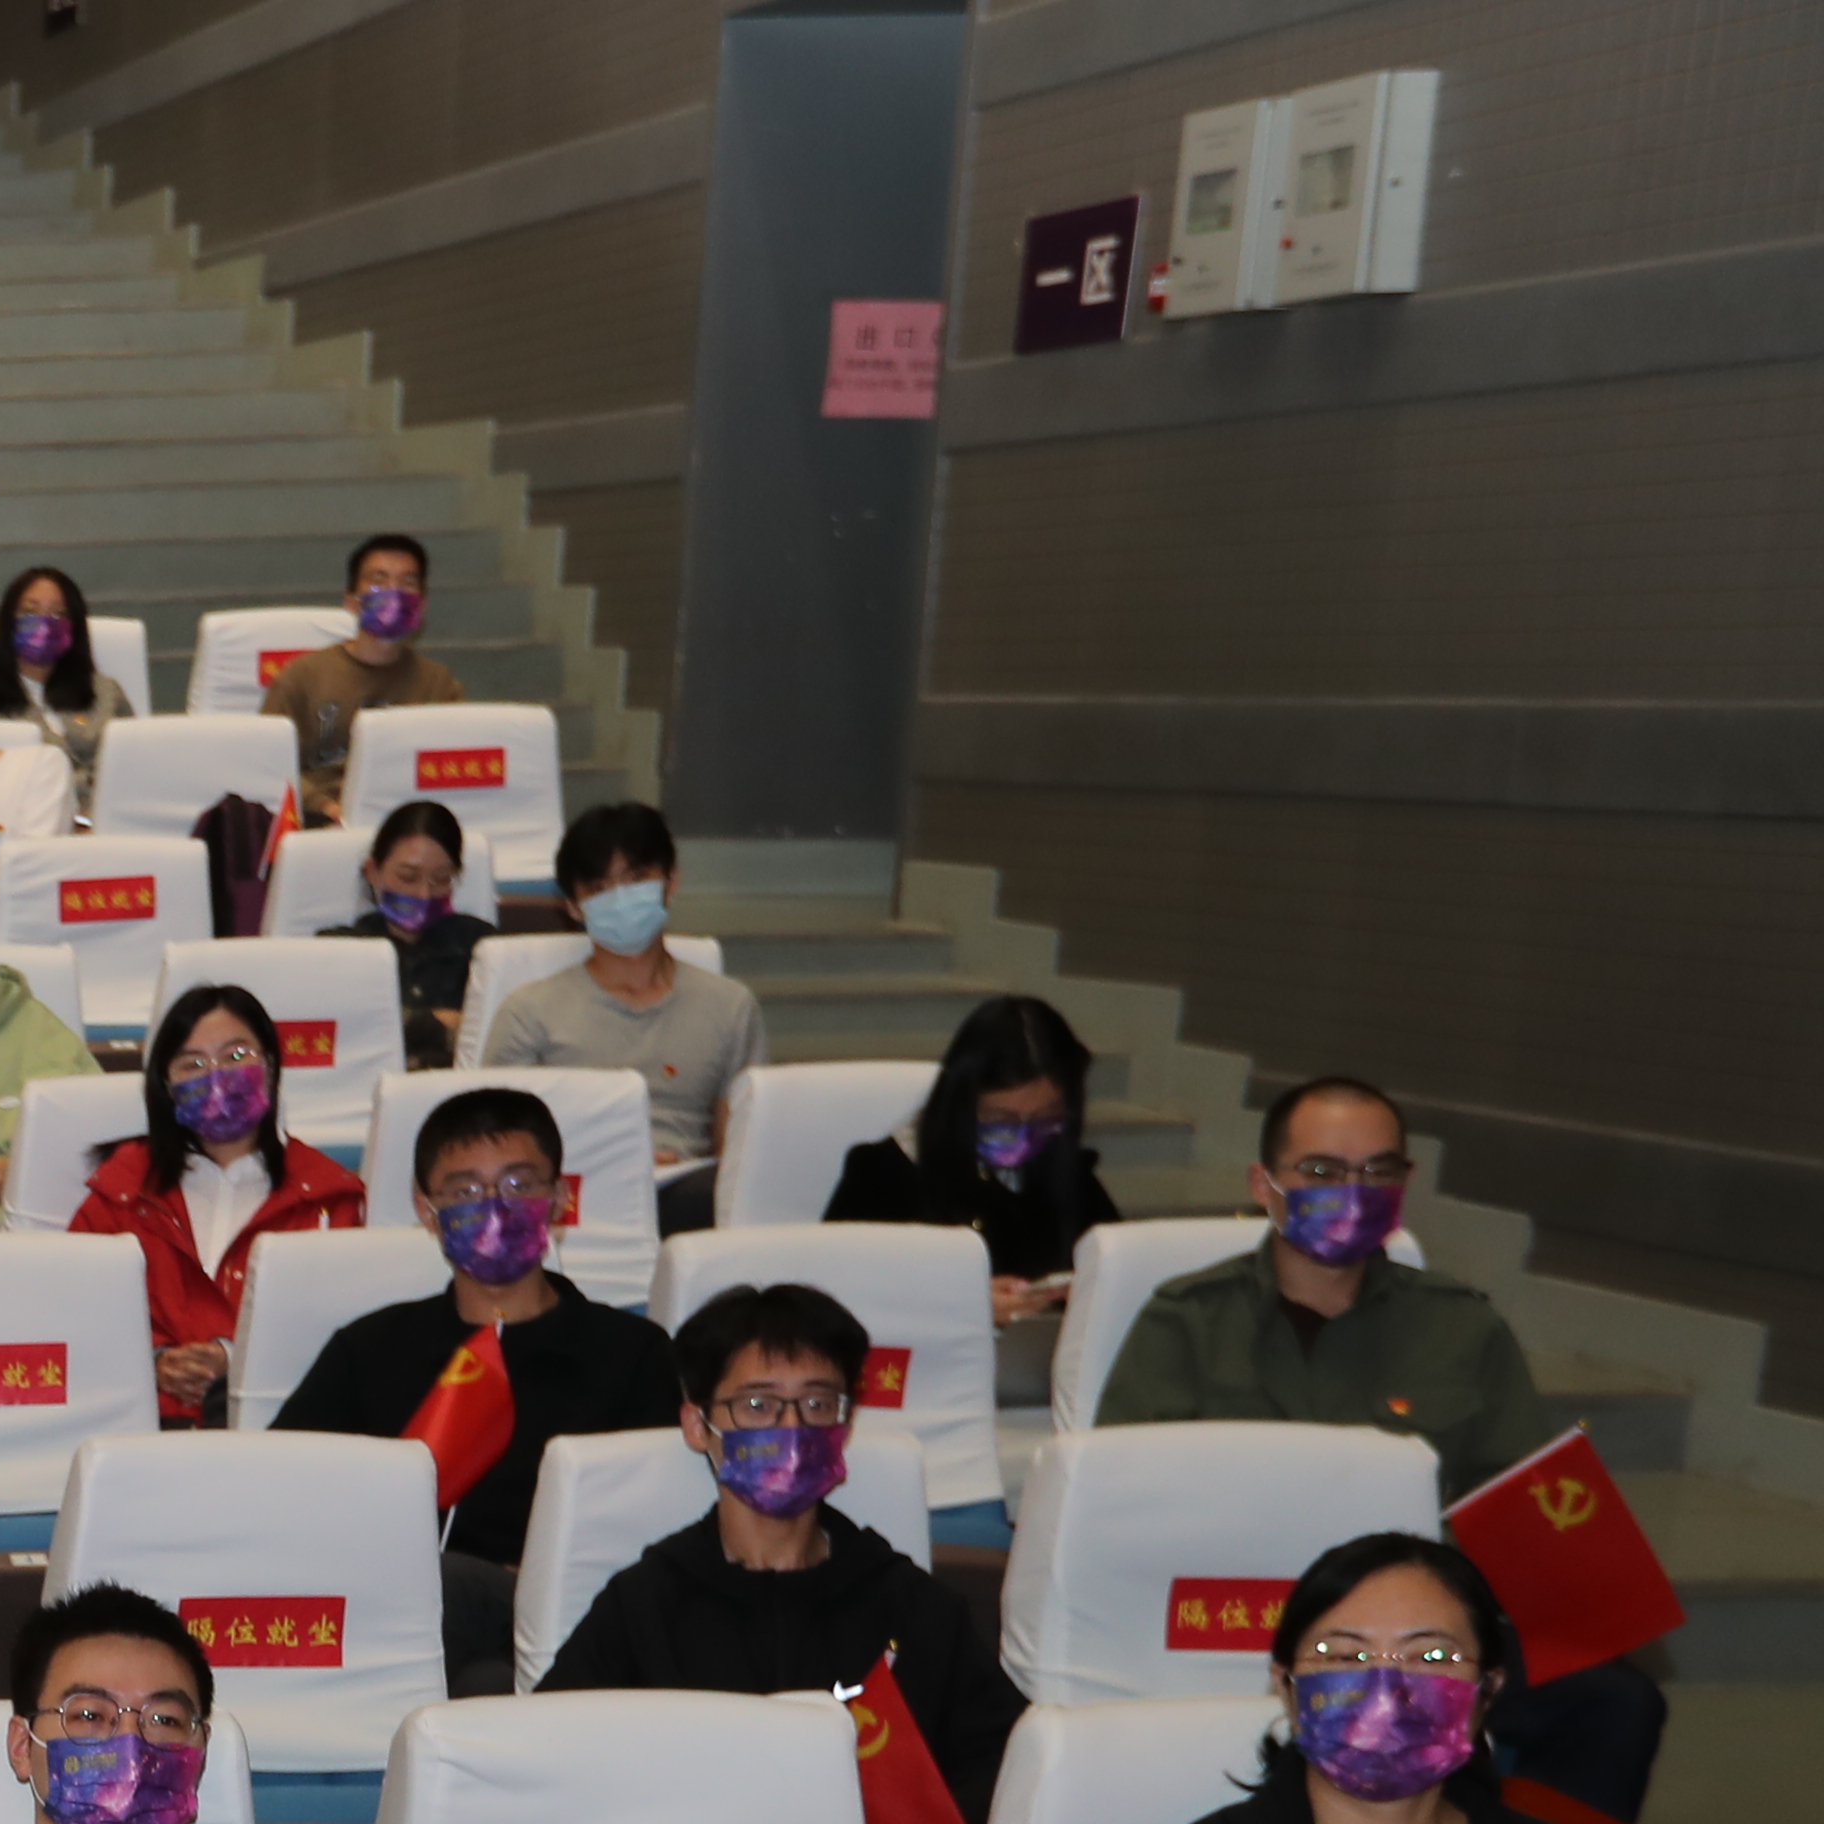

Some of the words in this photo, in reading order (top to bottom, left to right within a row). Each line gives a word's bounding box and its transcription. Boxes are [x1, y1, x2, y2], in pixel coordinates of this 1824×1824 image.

[1035, 233, 1121, 307] 一区
[1177, 1597, 1287, 1632] 隔位就
